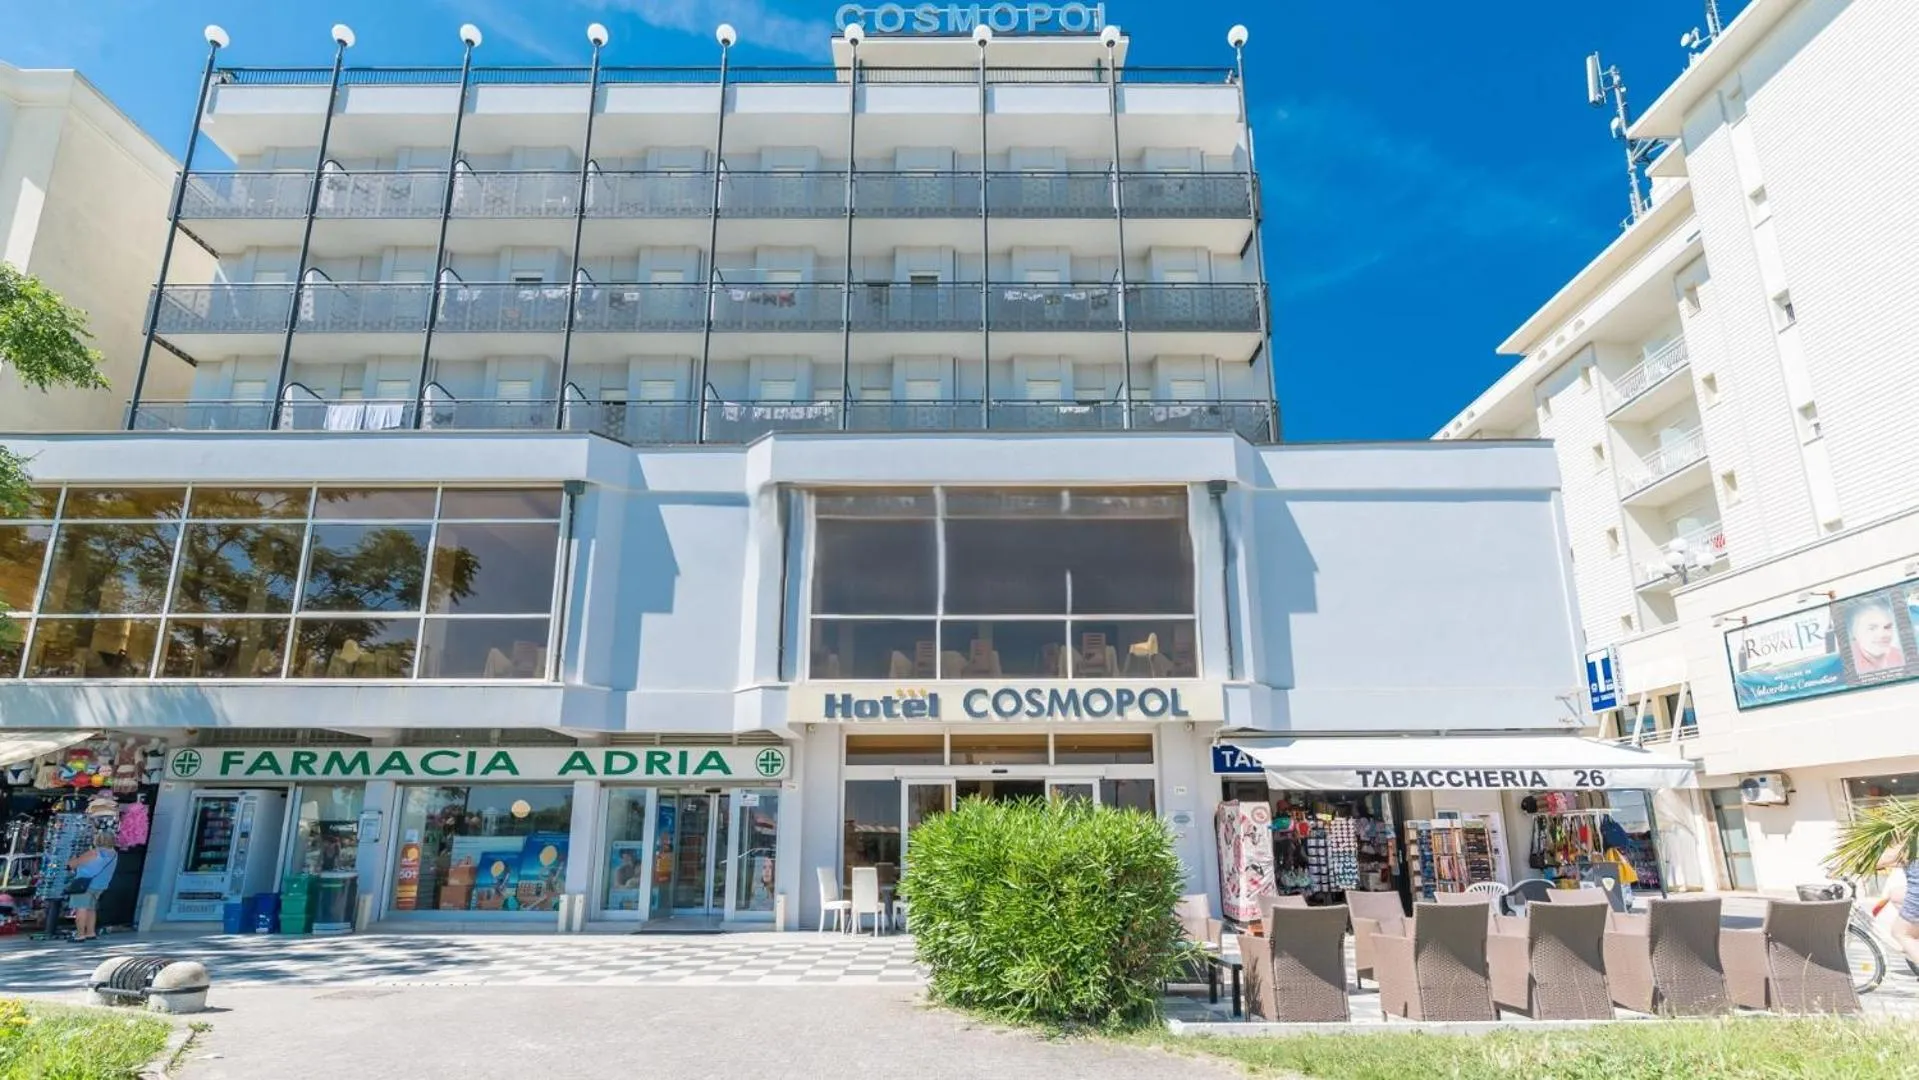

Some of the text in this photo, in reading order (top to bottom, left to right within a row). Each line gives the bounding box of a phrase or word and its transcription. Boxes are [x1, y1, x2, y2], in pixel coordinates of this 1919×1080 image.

[835, 2, 1121, 32] COSMOPOL
[1745, 637, 1796, 659] ROYAL
[825, 687, 1189, 719] Hotel COSMOPOL
[220, 750, 730, 777] FARMACIA ADRIA
[1355, 769, 1606, 789] TABACCHERIA 26
